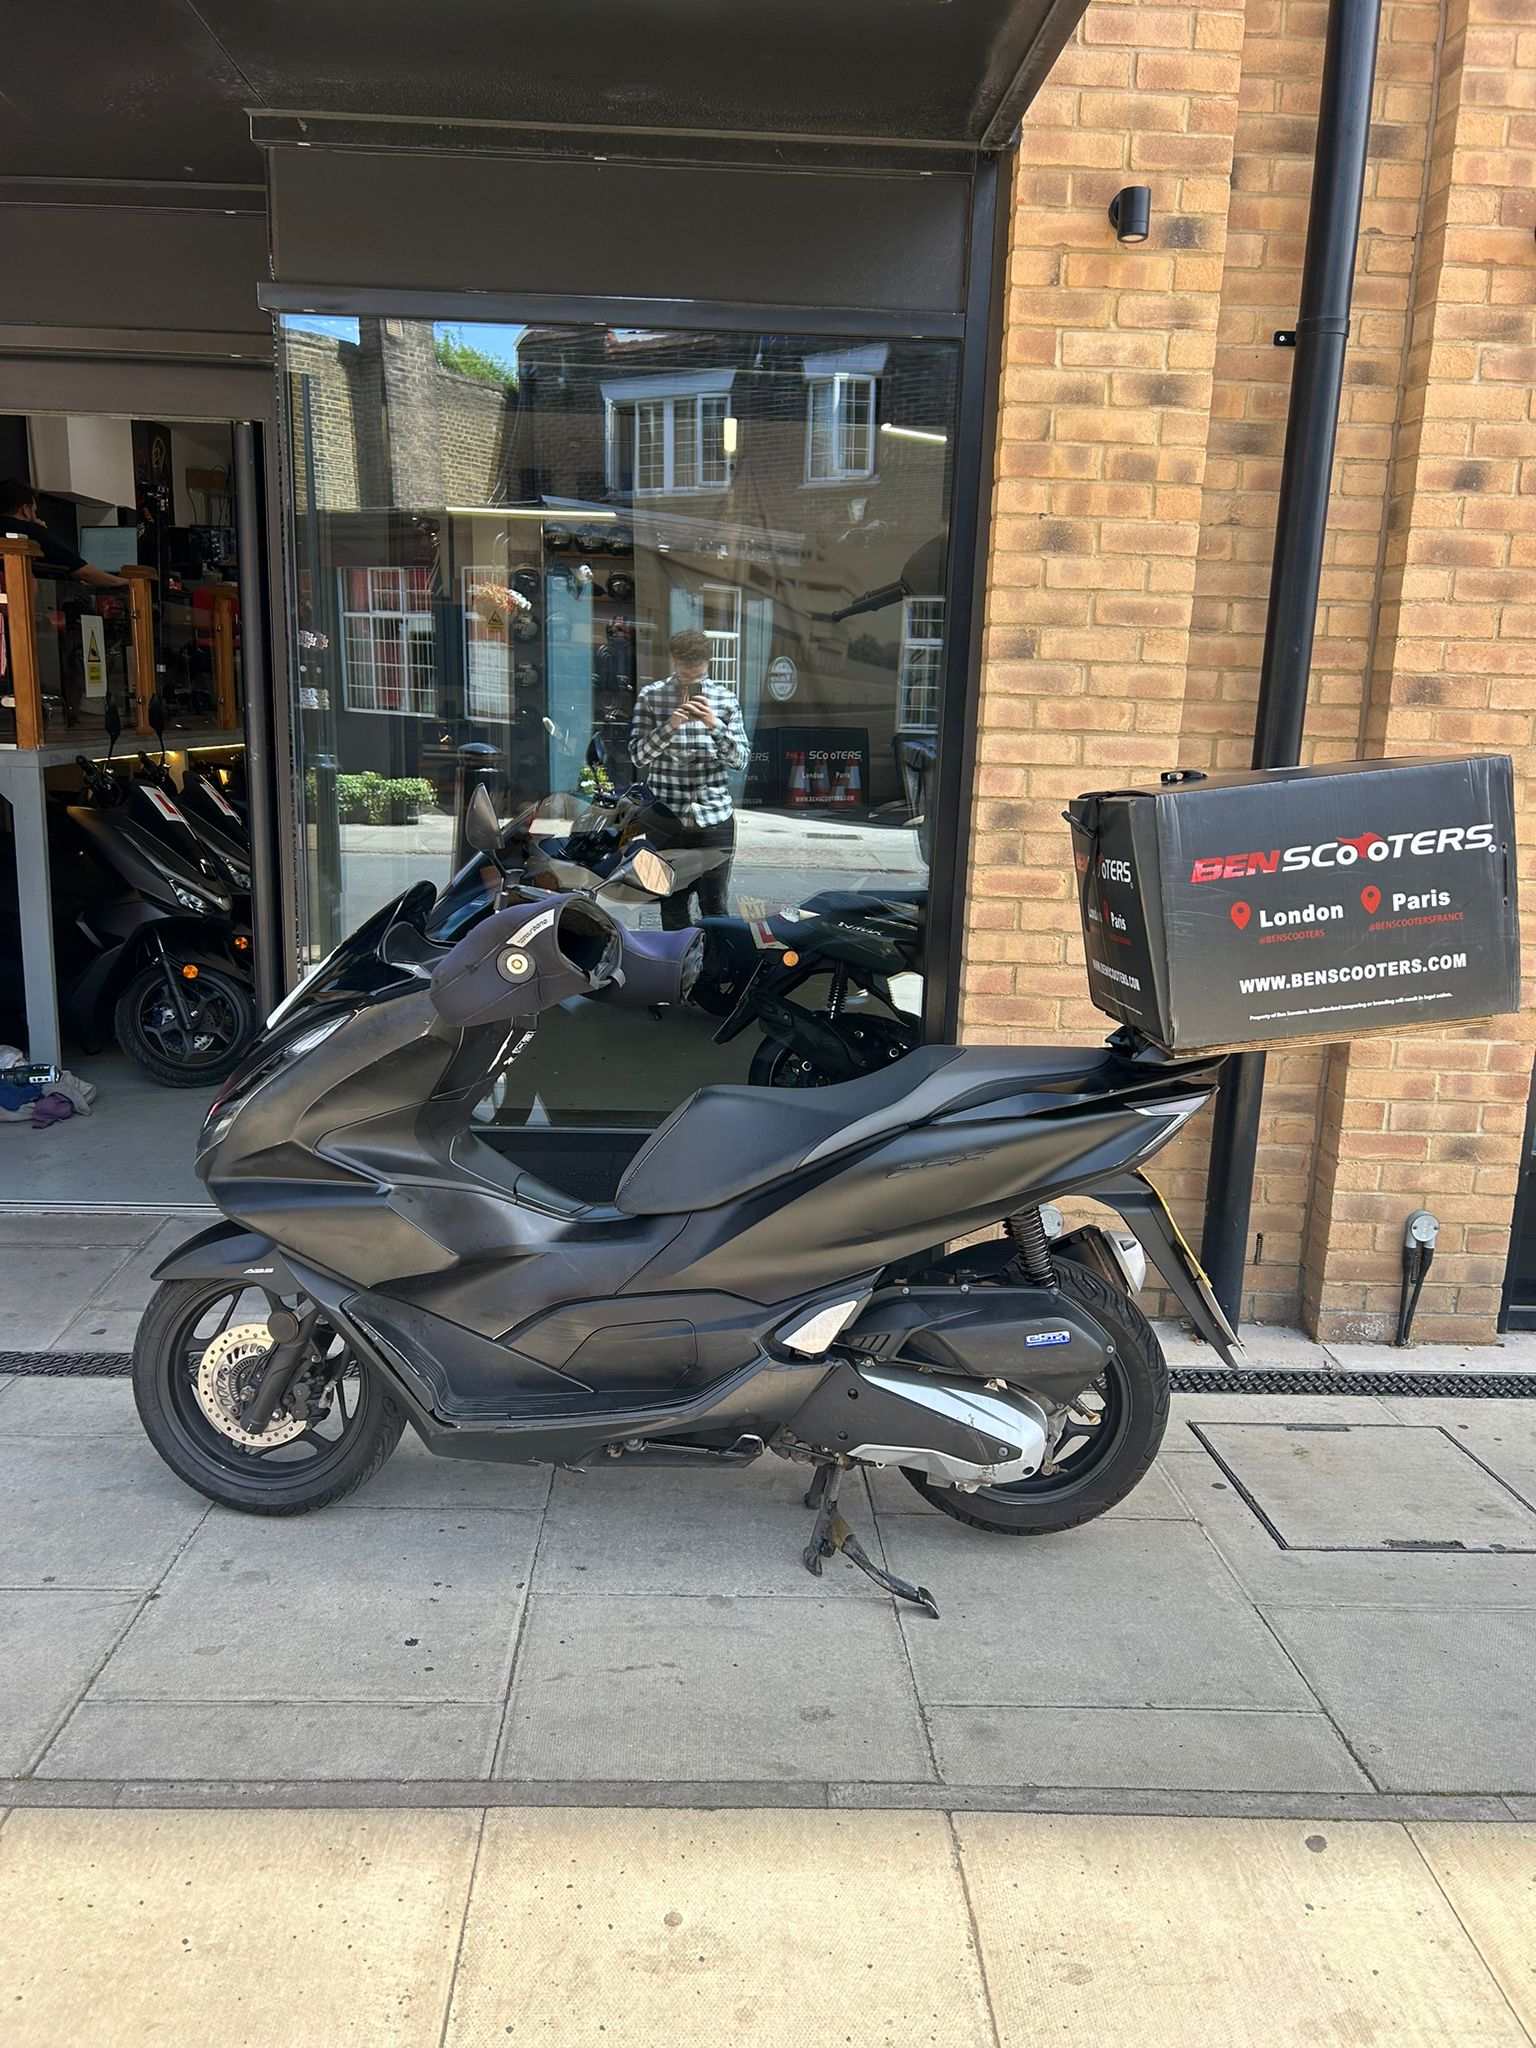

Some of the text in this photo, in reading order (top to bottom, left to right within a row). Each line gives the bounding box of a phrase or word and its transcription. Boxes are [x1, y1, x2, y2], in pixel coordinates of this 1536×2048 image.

[1392, 888, 1451, 912] Paris
[1259, 903, 1344, 928] London
[1369, 911, 1465, 932] @BENSCOOTERSFRANCE
[1258, 929, 1326, 945] @BENSCOOTERS
[1239, 952, 1467, 994] WWW.BENSCOOTERS.COM
